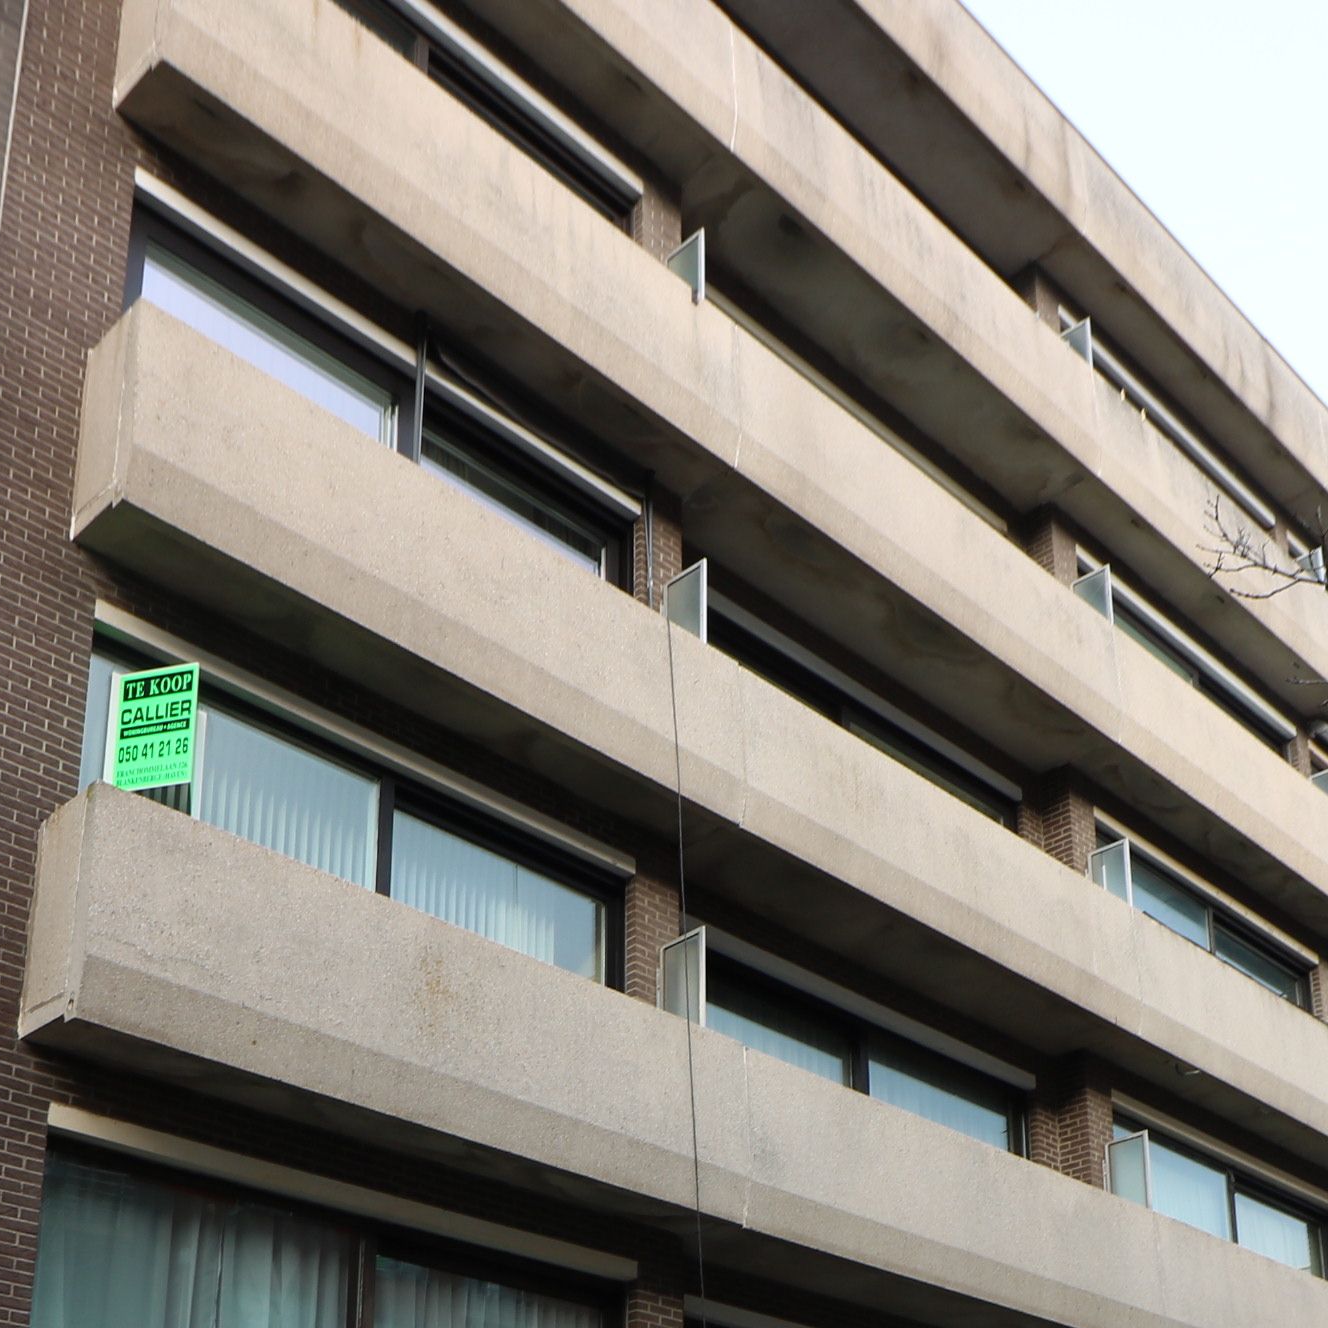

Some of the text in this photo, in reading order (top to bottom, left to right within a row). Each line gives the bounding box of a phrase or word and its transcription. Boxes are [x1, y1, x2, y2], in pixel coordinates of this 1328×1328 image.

[126, 673, 192, 699] TE KOOP
[121, 700, 192, 725] CALLIER
[118, 737, 189, 764] 050 41 21 26
